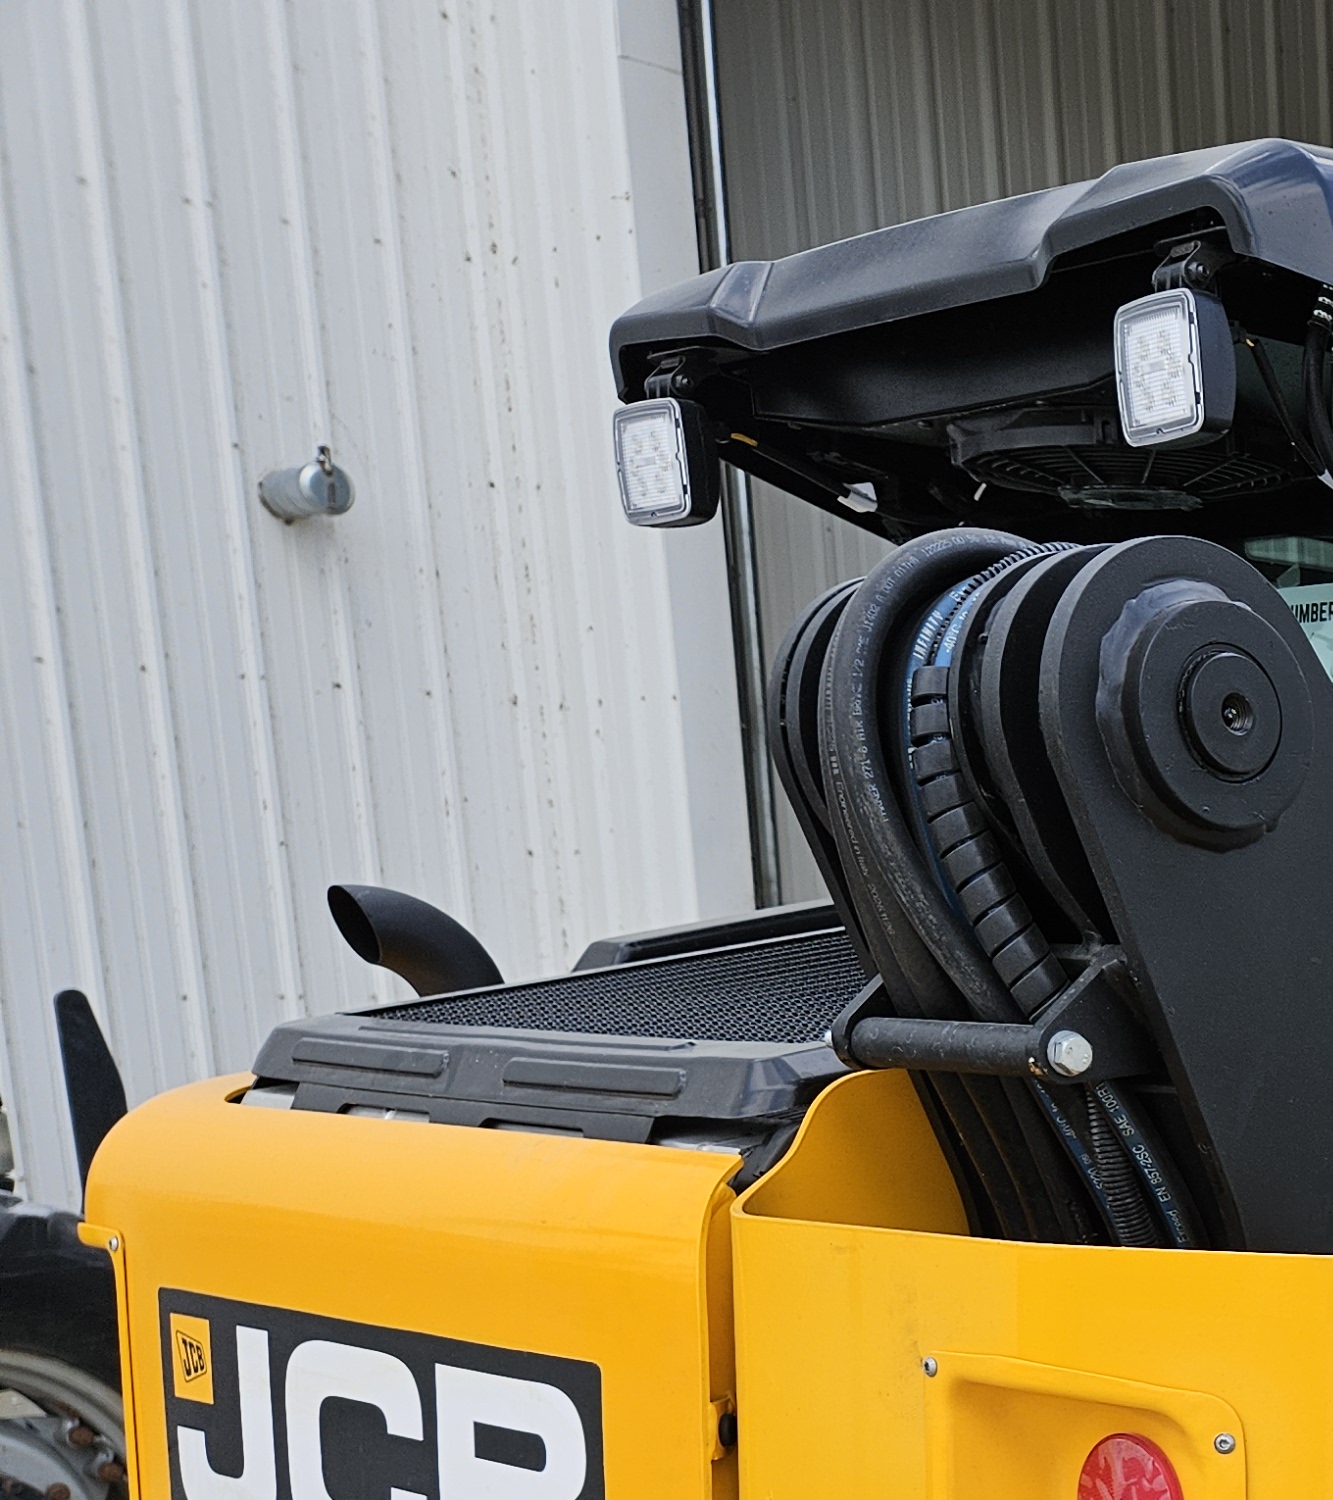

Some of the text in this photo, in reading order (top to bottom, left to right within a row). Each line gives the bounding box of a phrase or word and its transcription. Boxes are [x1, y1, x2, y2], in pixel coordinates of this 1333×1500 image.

[1113, 1114, 1135, 1136] SAE
[1155, 1187, 1172, 1203] EN
[181, 1337, 206, 1377] JCB
